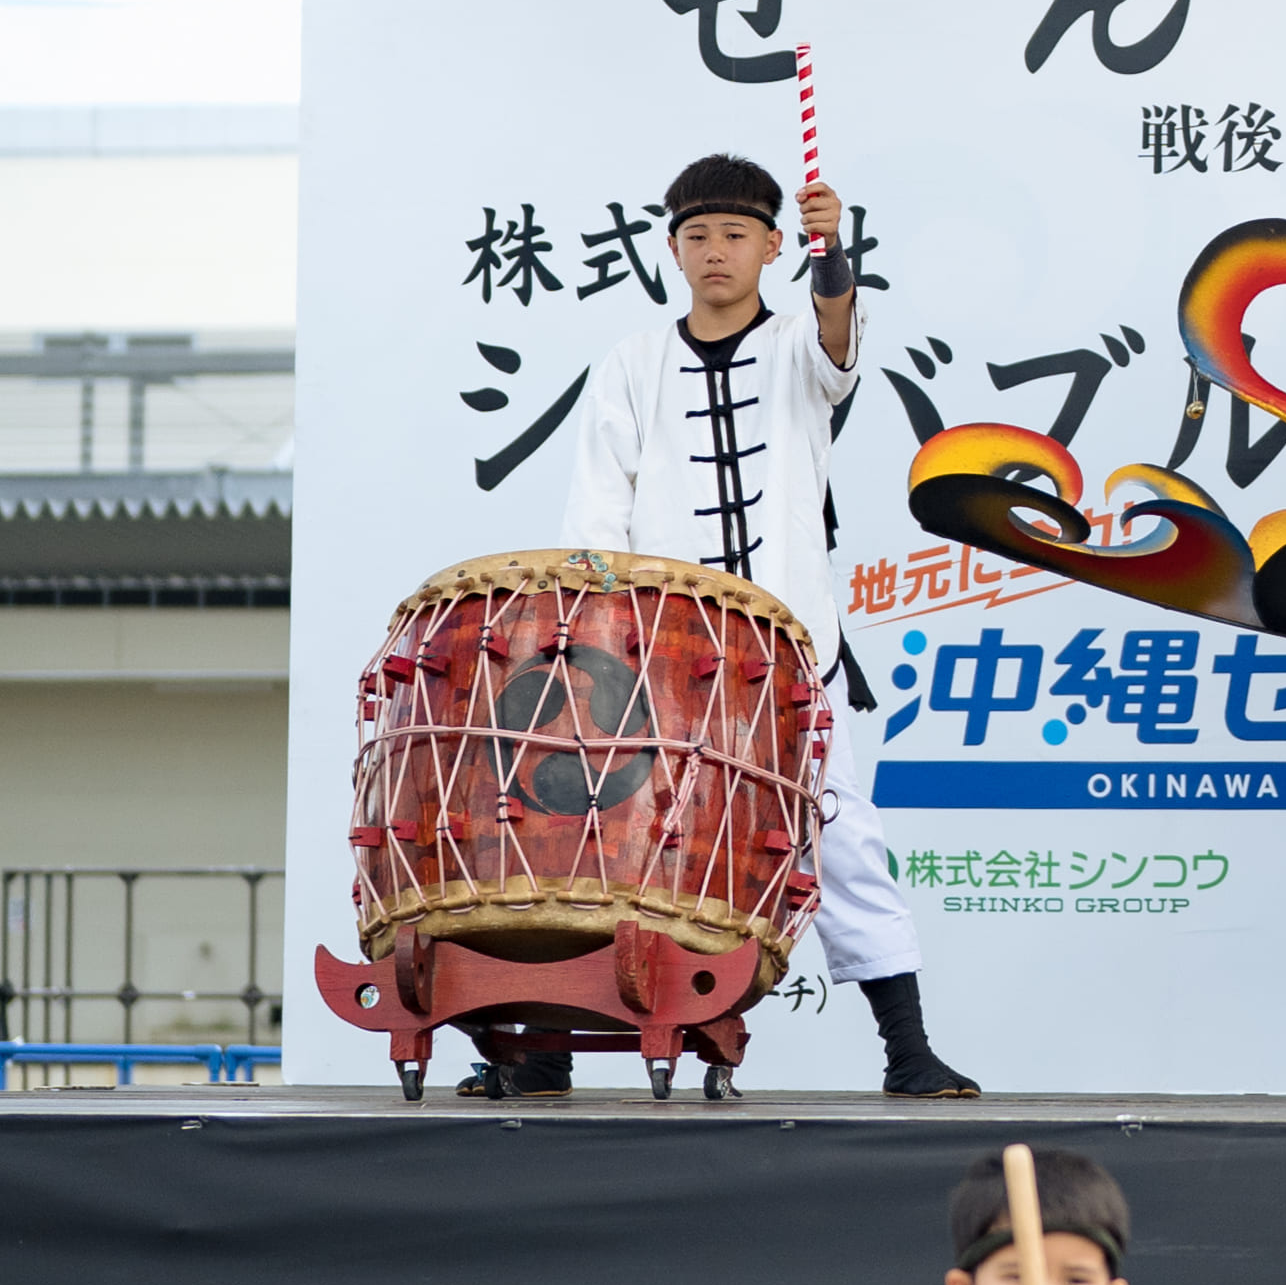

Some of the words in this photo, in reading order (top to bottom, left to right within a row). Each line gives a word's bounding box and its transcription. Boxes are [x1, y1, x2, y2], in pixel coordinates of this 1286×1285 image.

[461, 201, 891, 307] 株式社
[1087, 773, 1280, 799] OKINAWA
[905, 849, 1230, 891] 株式会社シンコウ
[943, 896, 1064, 914] SHINKO
[1074, 896, 1190, 914] GROUP
